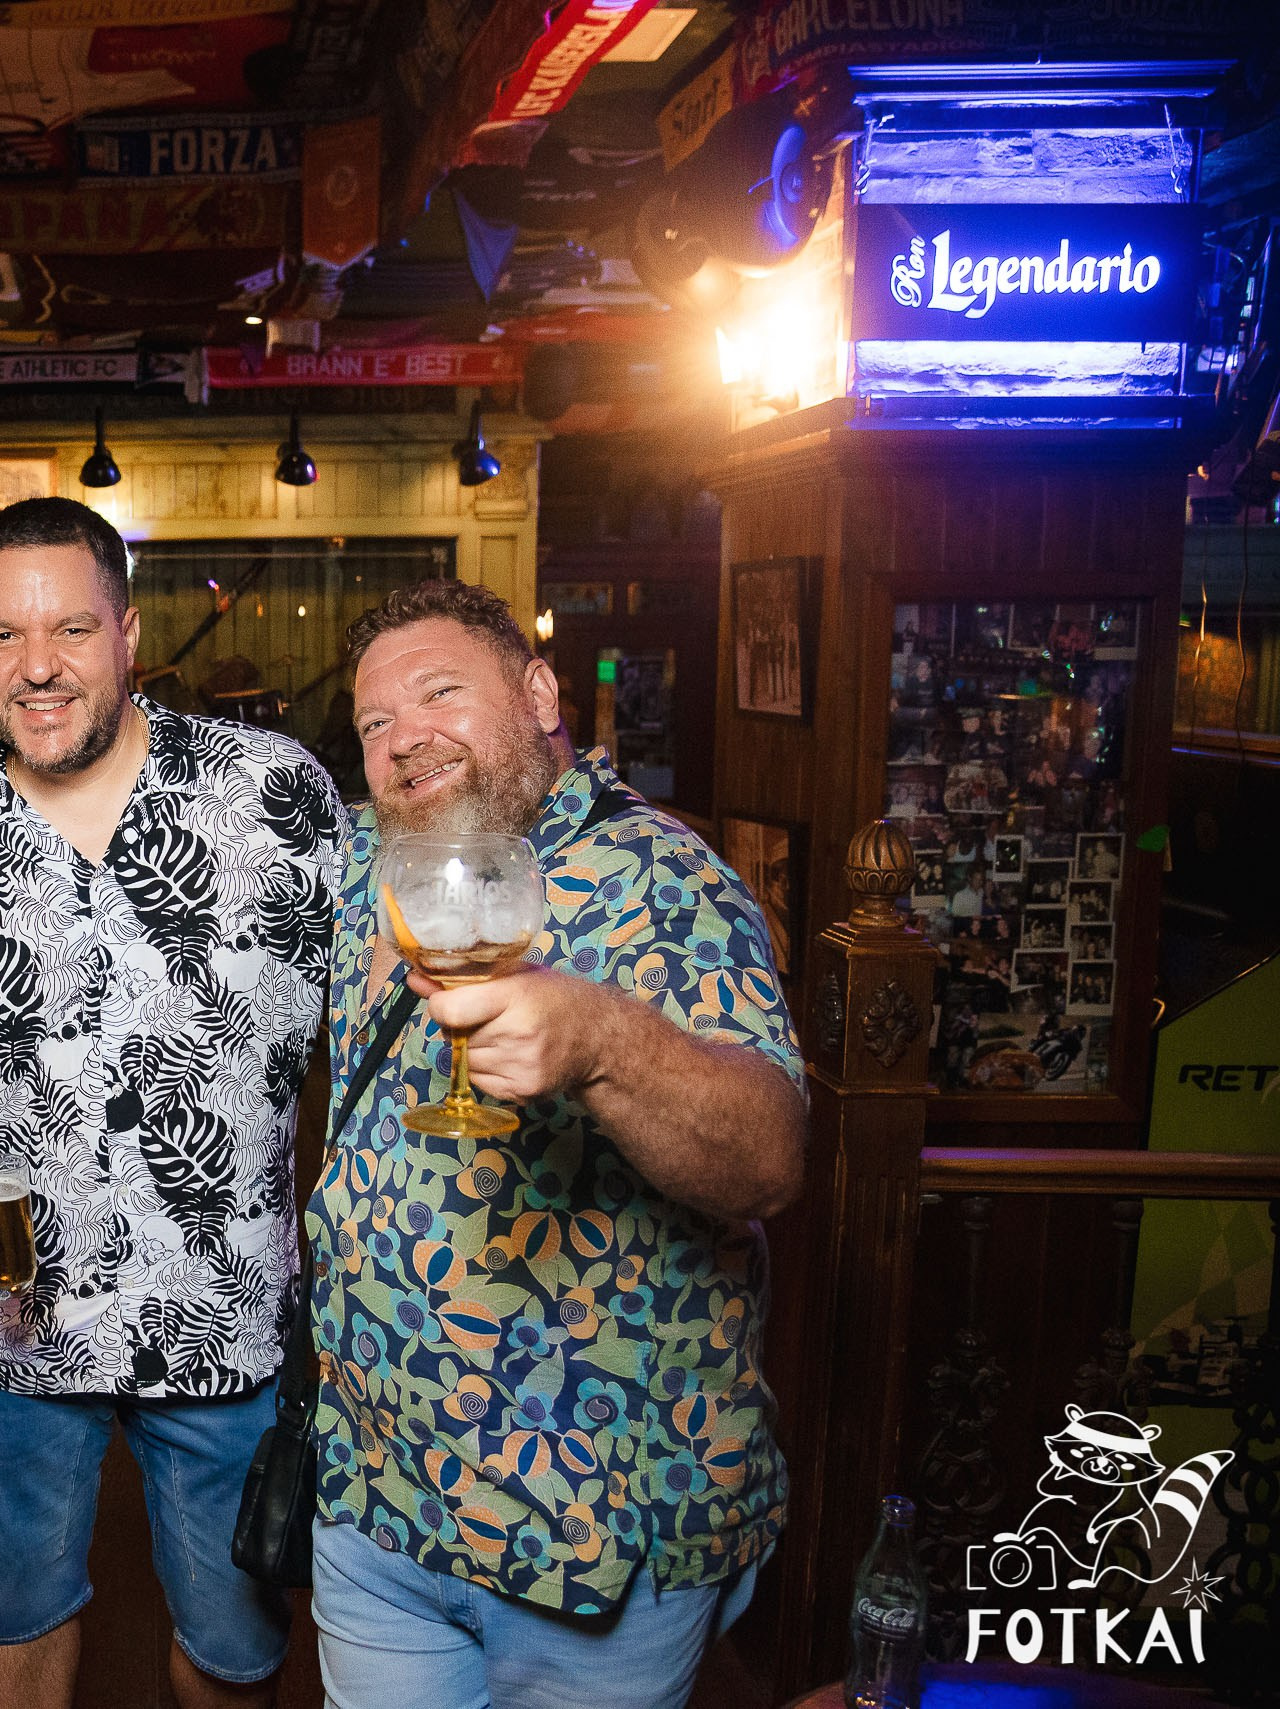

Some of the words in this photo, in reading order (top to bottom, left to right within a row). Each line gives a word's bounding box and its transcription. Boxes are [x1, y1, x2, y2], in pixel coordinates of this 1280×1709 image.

[149, 127, 278, 176] FORZA
[890, 235, 925, 307] Ron
[927, 229, 1160, 318] Legendario
[11, 359, 88, 379] ATHLETIC
[92, 359, 117, 376] FC
[287, 355, 362, 377] BRANN
[405, 354, 467, 377] BEST
[1178, 1064, 1279, 1092] RET
